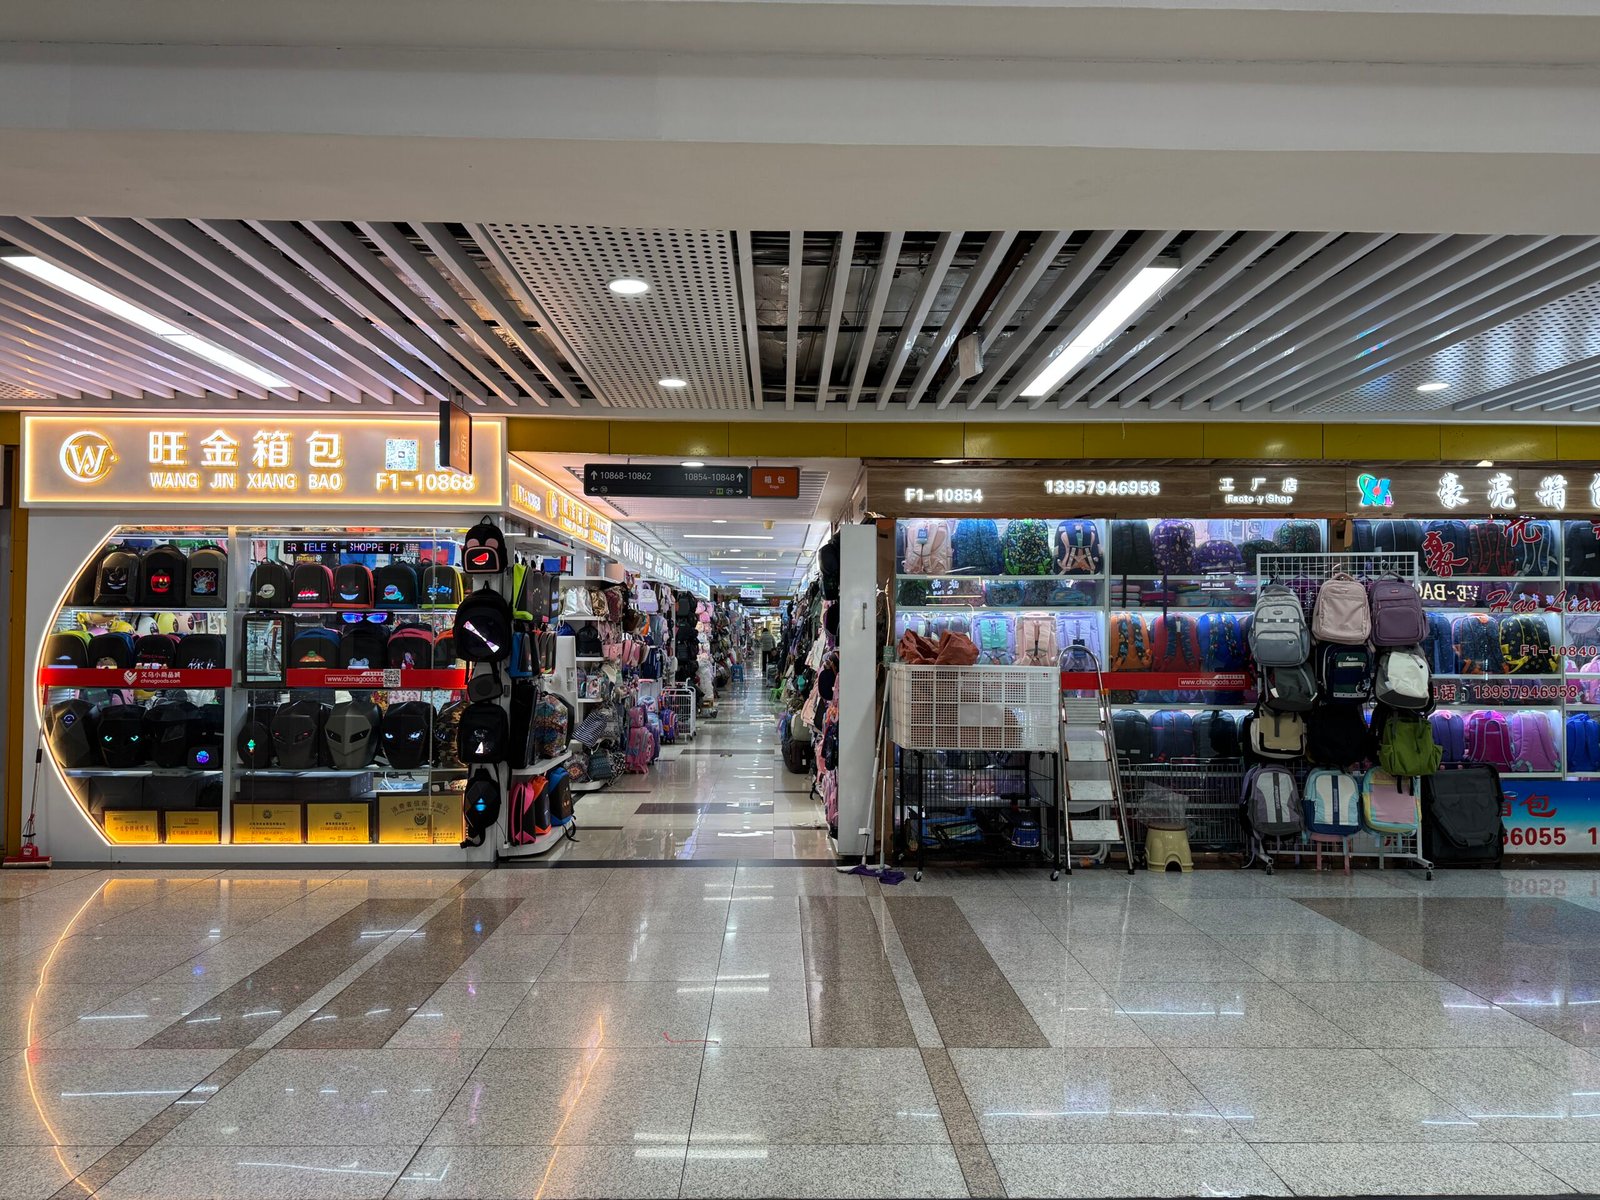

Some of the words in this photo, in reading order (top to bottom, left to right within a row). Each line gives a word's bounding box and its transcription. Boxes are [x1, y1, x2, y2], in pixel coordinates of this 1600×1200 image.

[148, 429, 343, 469] 旺金箱包
[149, 472, 200, 489] WANG
[209, 472, 236, 489] JIN
[246, 472, 297, 490] XIANG
[308, 473, 343, 490] BAO
[375, 471, 476, 492] F1-10868
[600, 471, 652, 480] 10868-10862
[684, 472, 736, 482] 10854-10848
[1044, 479, 1162, 496] 13957946958
[1218, 477, 1299, 493] 工厂店
[904, 487, 984, 503] F1-10854
[1266, 494, 1294, 505] Shop
[303, 542, 327, 552] TELE
[1486, 589, 1538, 613] Hao
[1519, 644, 1597, 657] F1-10840
[1180, 679, 1244, 687] www.chinagoods.com
[1473, 685, 1578, 699] 13957946958
